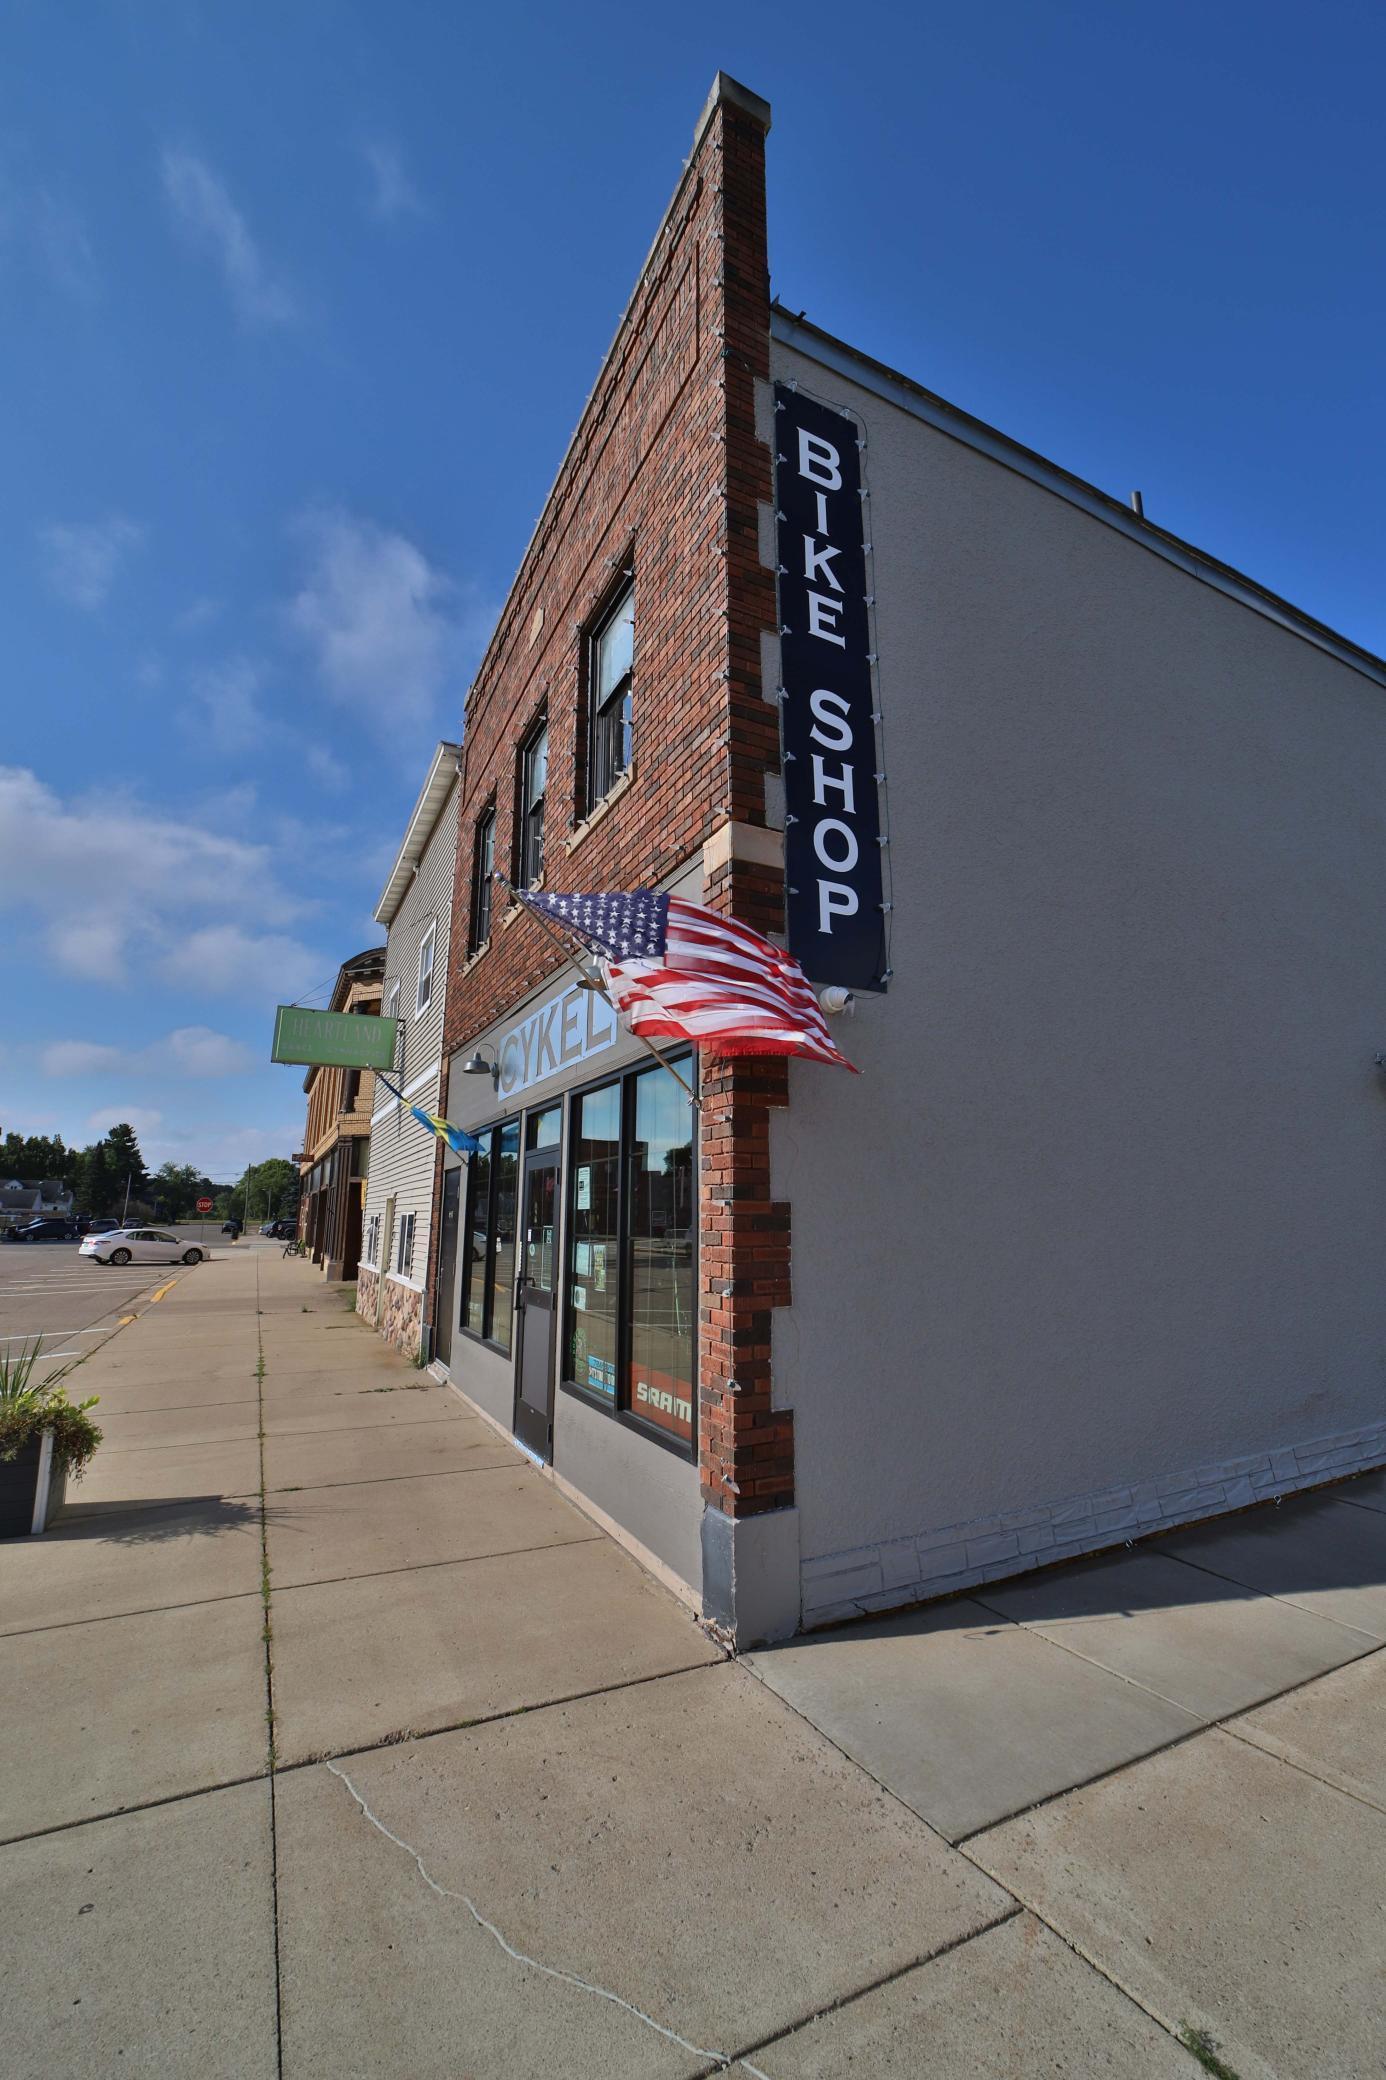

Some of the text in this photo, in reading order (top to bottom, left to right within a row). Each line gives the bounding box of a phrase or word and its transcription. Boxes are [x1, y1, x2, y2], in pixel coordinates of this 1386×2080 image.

[796, 426, 859, 935] BIKE SHOP
[292, 1017, 382, 1043] HEARTLAND
[500, 985, 613, 1094] CYKEL
[636, 1381, 692, 1424] SRAM
